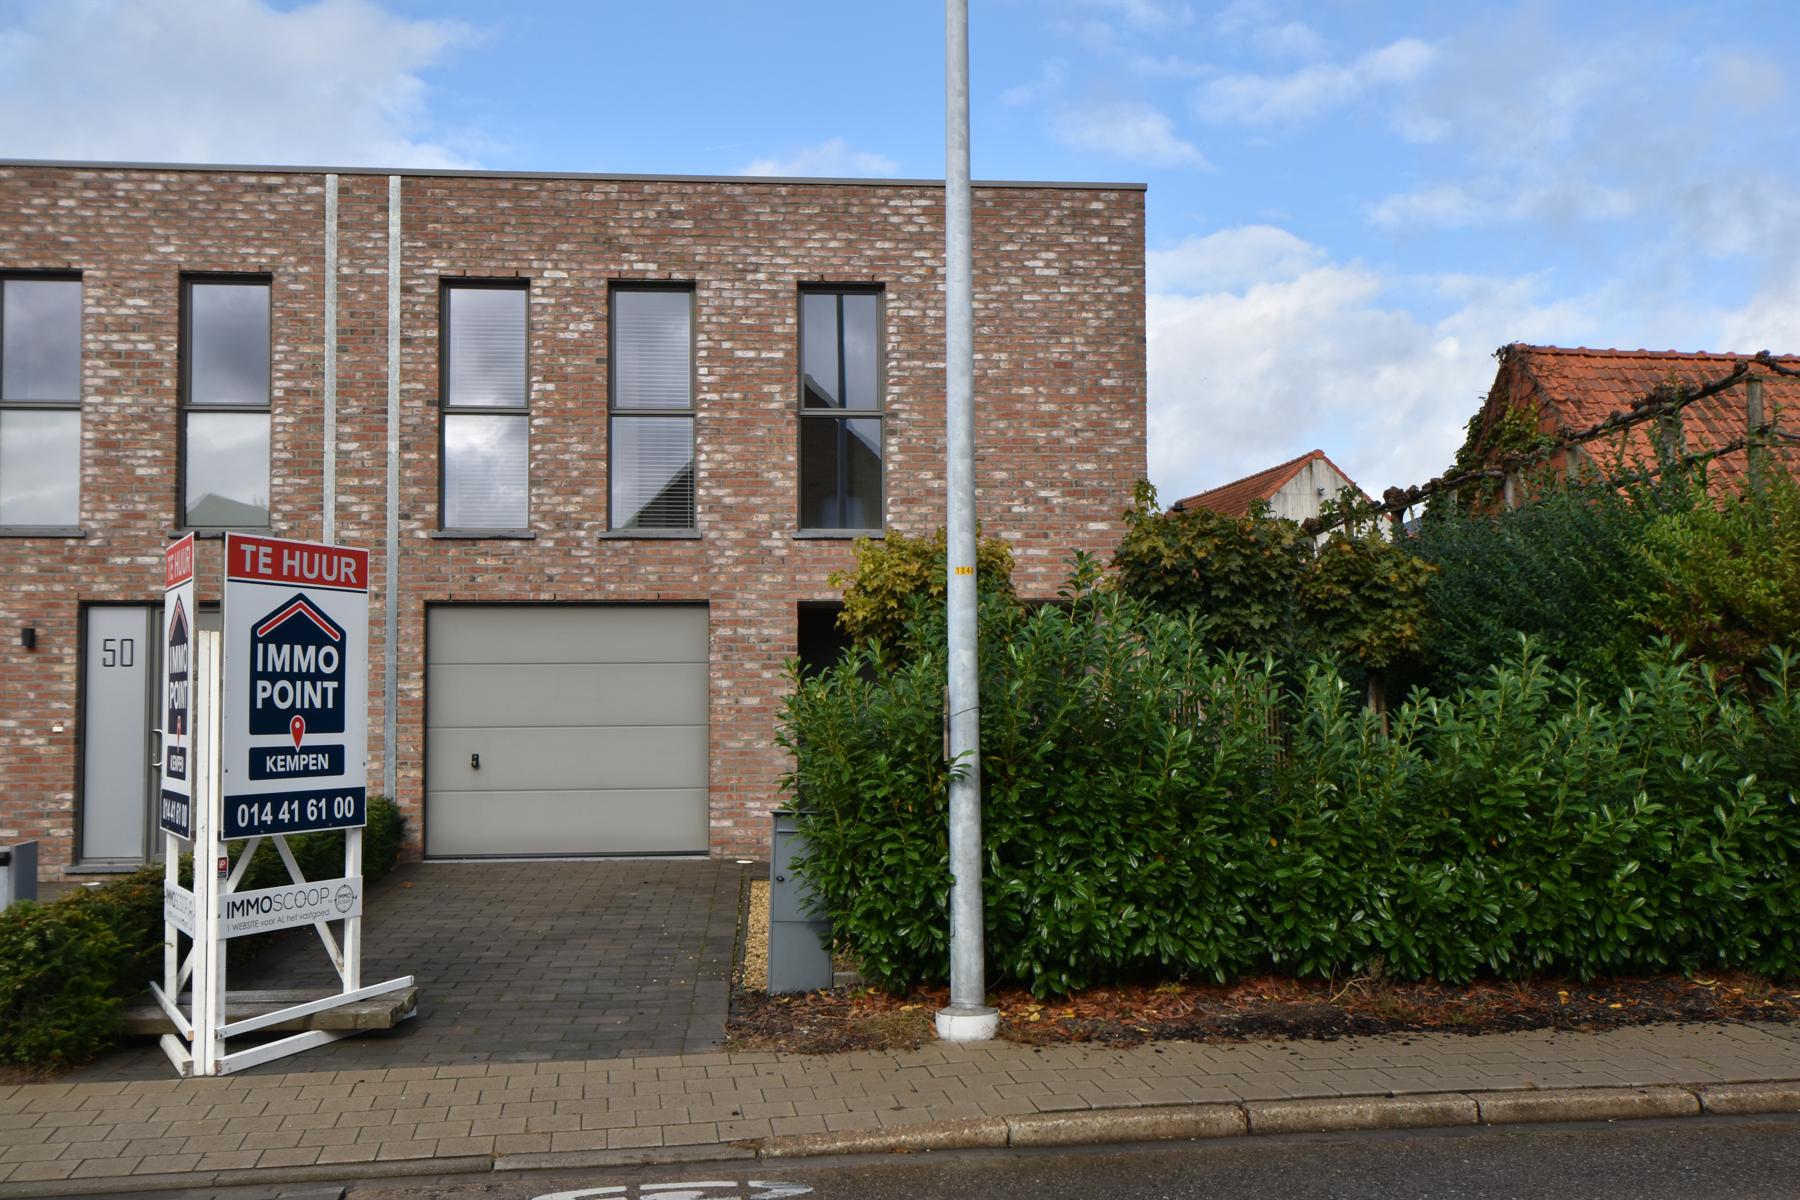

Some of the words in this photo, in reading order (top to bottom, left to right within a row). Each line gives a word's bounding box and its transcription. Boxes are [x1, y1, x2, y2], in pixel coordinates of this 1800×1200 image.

[240, 543, 273, 575] TE
[282, 549, 357, 584] HUUR
[103, 638, 134, 667] 50
[169, 642, 187, 674] IMMO
[256, 643, 339, 674] IMMO
[169, 680, 187, 710] POINT
[256, 679, 338, 710] POINT
[265, 753, 329, 772] KEMPEN
[237, 802, 273, 828] 014
[278, 800, 299, 823] 41
[306, 798, 326, 821] 61
[334, 796, 355, 819] 00
[232, 919, 259, 931] WEBSITE
[260, 918, 276, 927] voor
[277, 915, 285, 924] AL
[286, 913, 298, 922] het
[299, 908, 330, 921] vastgoed
